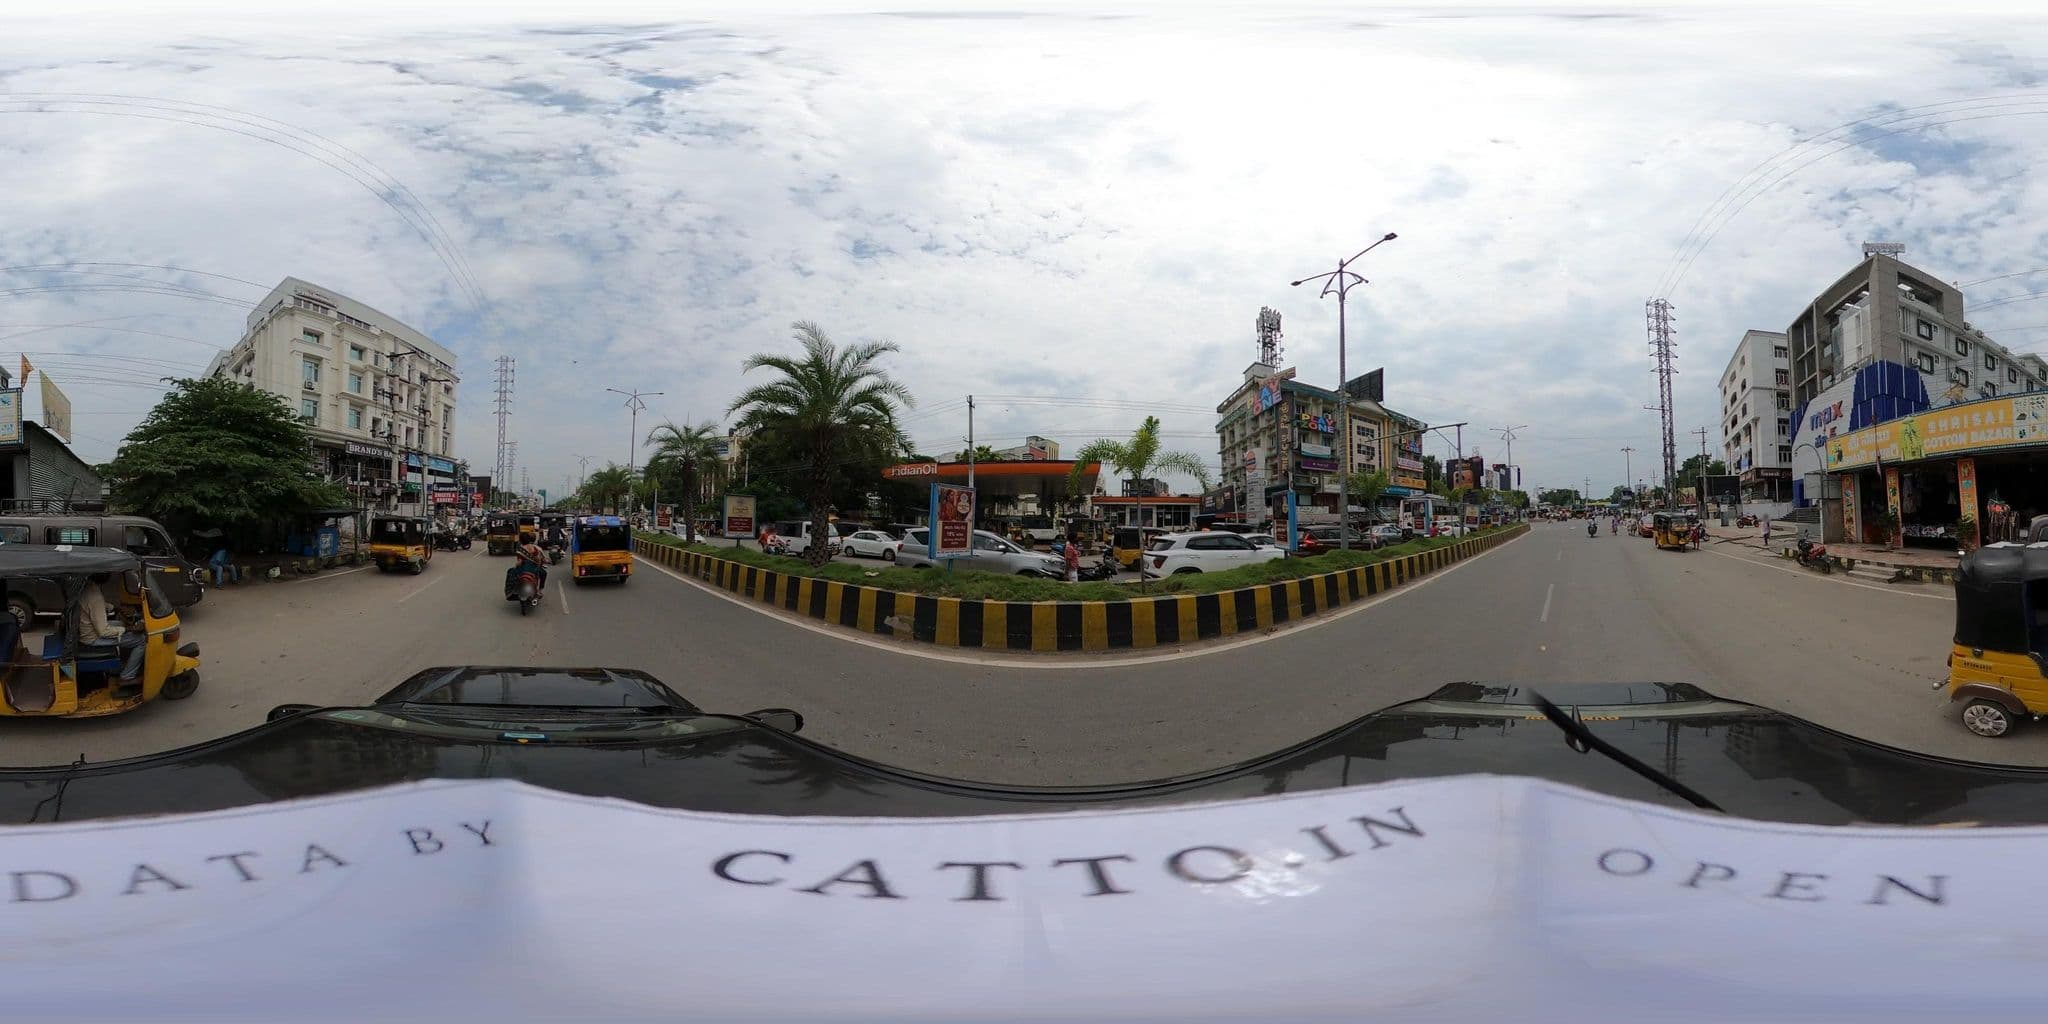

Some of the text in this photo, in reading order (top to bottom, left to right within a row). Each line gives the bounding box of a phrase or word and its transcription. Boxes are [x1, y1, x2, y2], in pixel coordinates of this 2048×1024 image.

[1302, 414, 1334, 426] PLAY
[1810, 400, 1843, 431] max
[1301, 420, 1335, 433] ZONE
[349, 444, 384, 457] BRAND'S
[892, 463, 938, 476] IndianOil
[9, 818, 497, 903] DATA BY
[1597, 846, 1951, 905] OPEN
